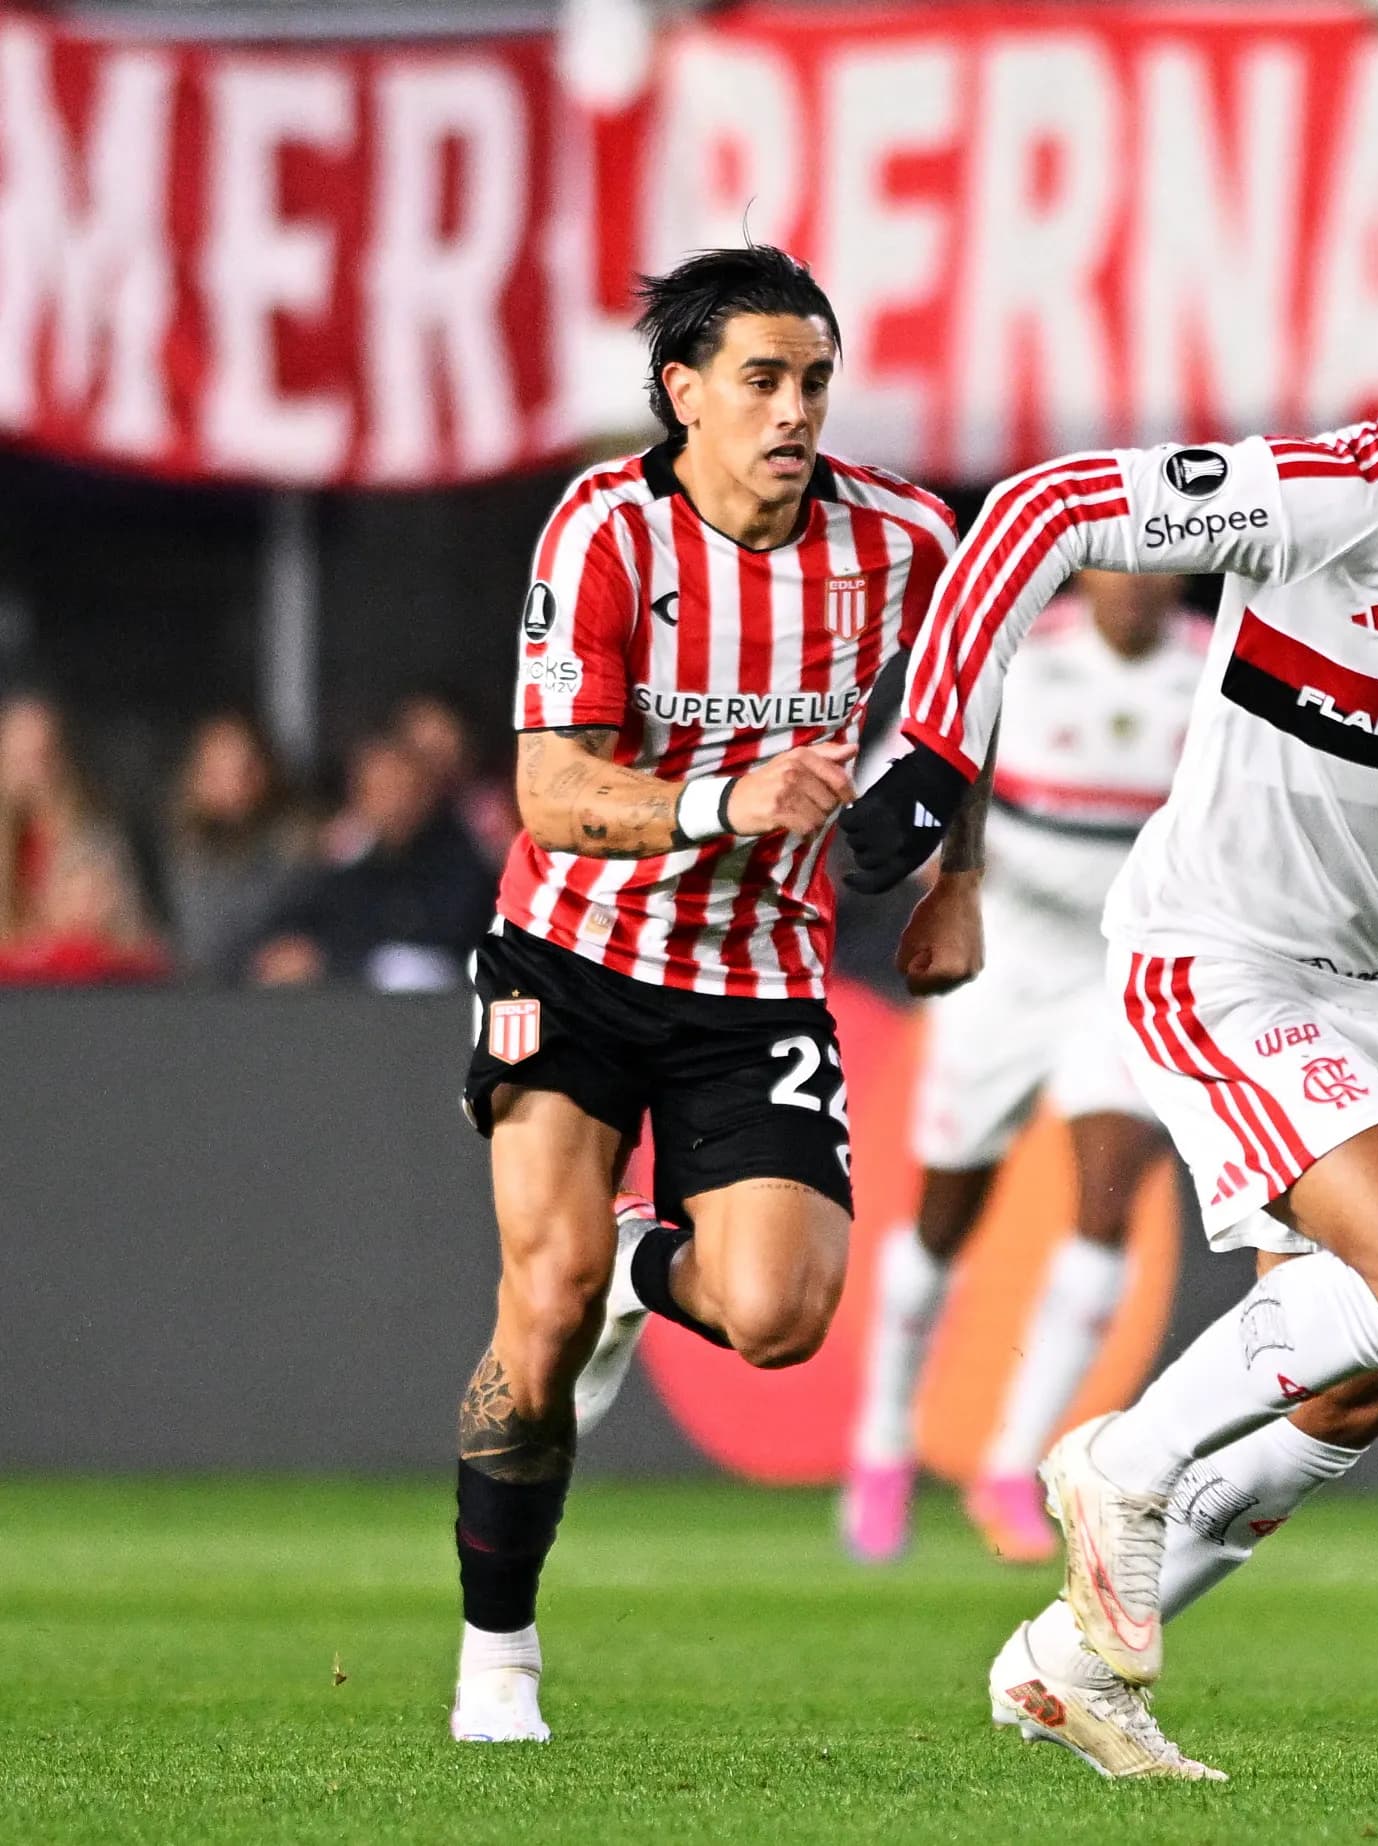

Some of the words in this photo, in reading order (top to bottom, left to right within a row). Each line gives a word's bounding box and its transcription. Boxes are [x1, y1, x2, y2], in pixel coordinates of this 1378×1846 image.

[1144, 508, 1269, 548] Shopee
[828, 579, 867, 590] EDLP
[634, 686, 859, 725] SUPERVIELLE
